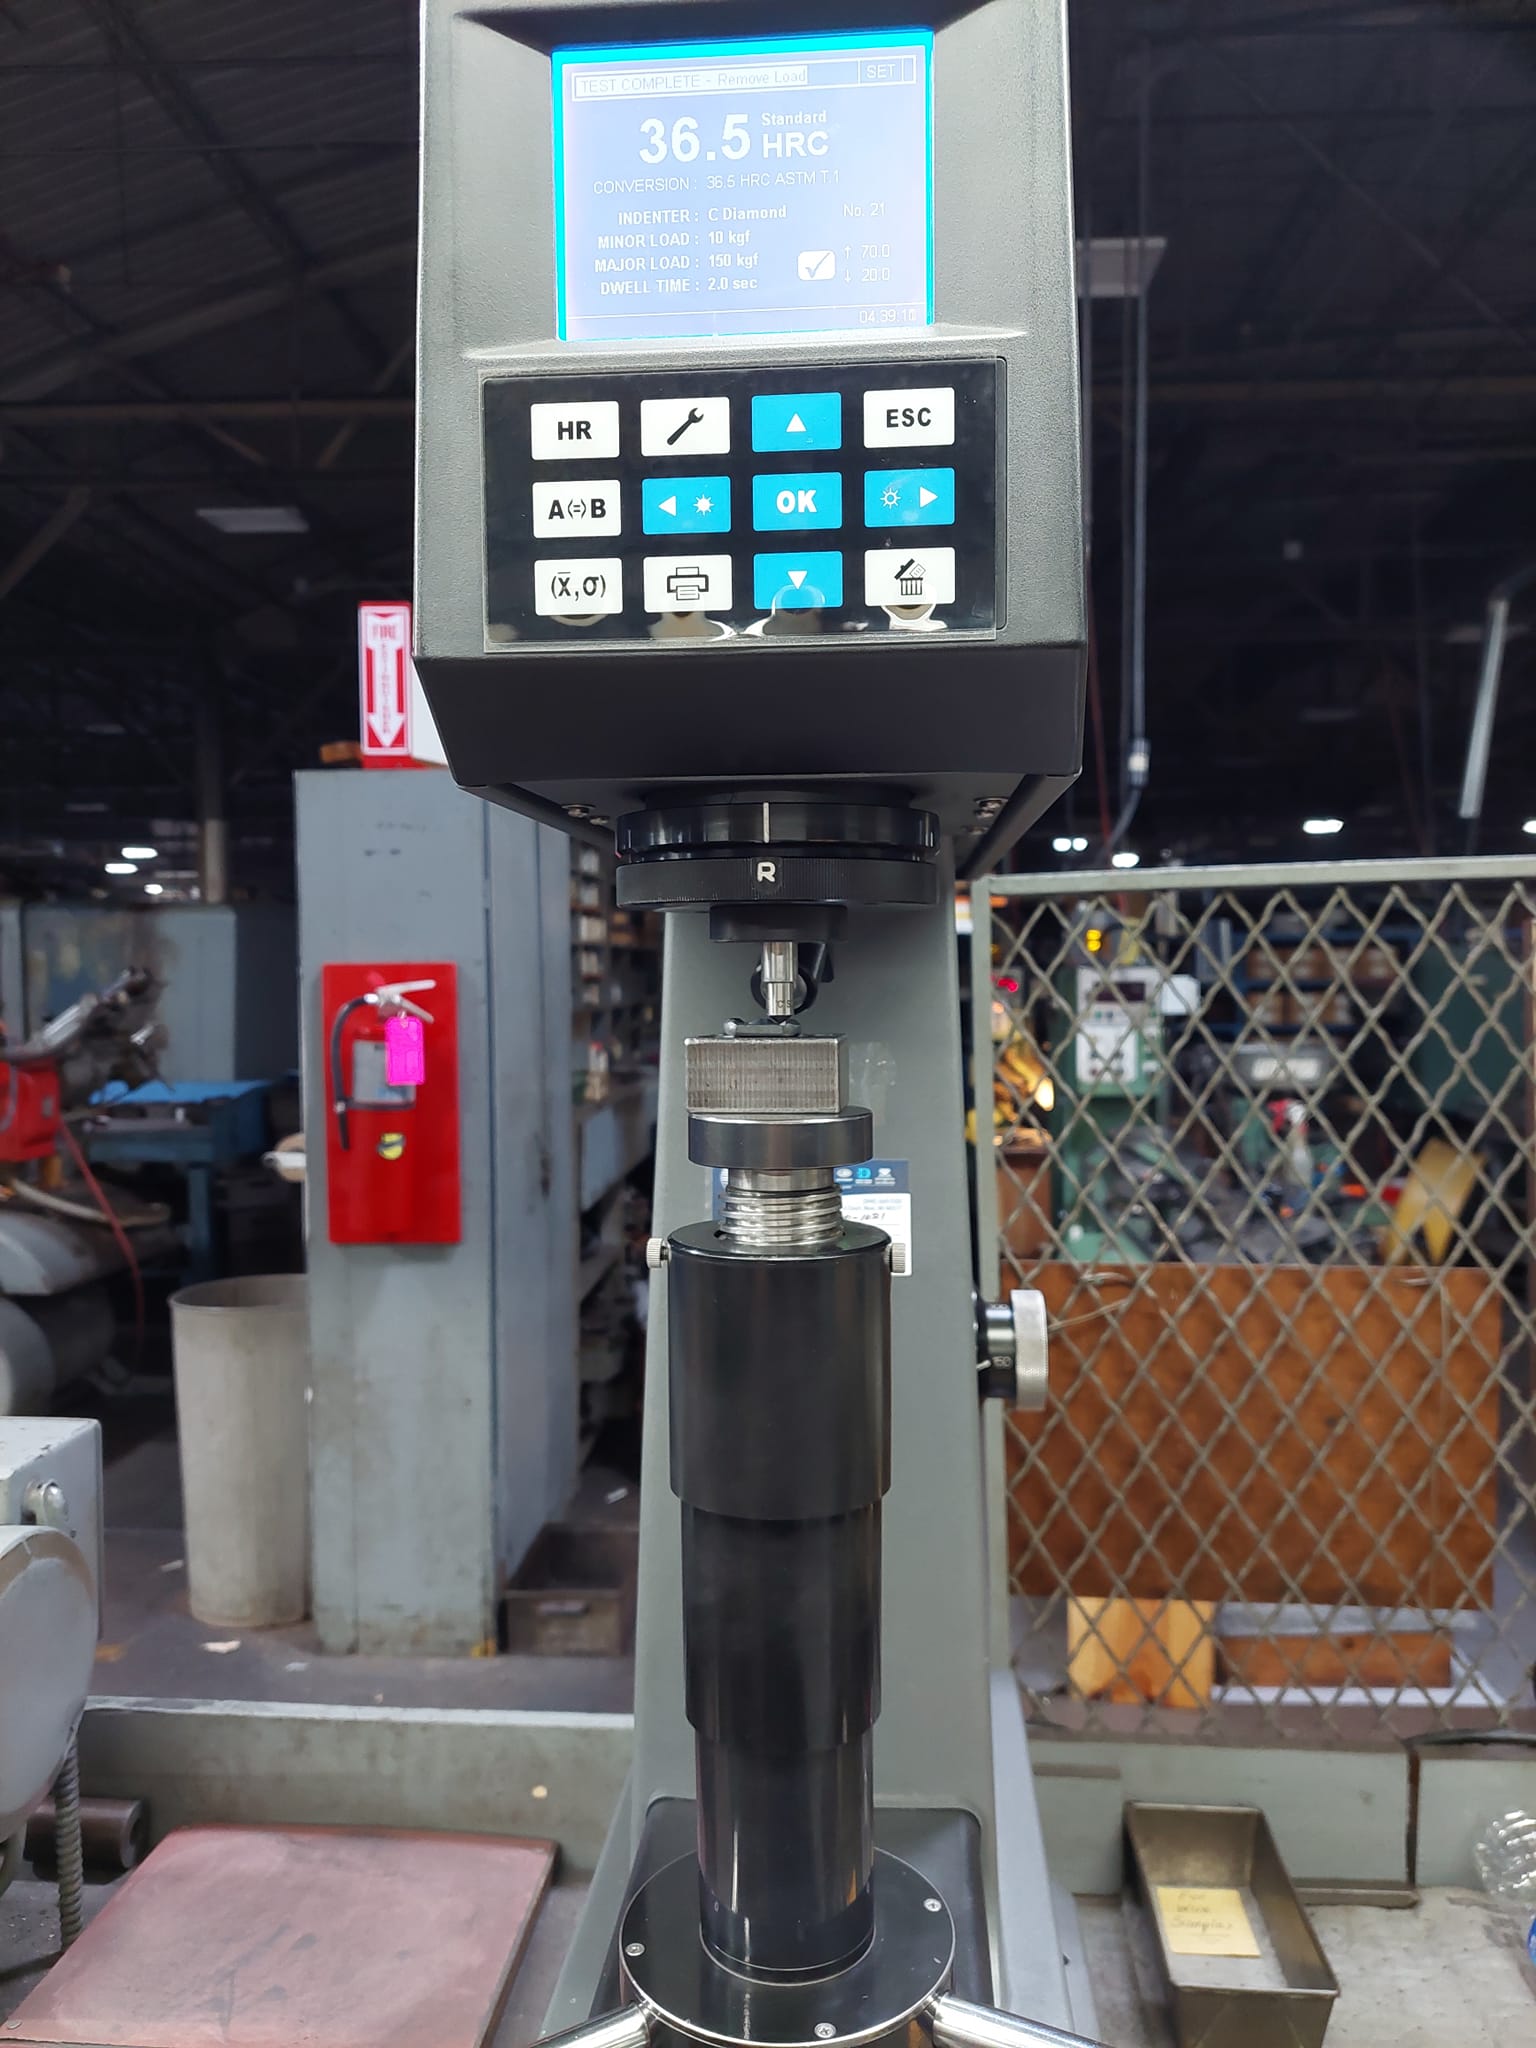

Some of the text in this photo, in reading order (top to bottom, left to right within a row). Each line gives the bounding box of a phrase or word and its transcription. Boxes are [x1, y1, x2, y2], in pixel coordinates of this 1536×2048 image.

[581, 78, 617, 93] TEST
[621, 73, 700, 91] COMPLETE
[717, 71, 770, 87] Remove
[774, 67, 806, 84] Load
[866, 64, 897, 79] SET
[761, 110, 827, 127] Standard
[639, 113, 829, 164] 36.5 HRC
[593, 177, 690, 195] CONVERSION
[706, 174, 736, 190] 36.5
[740, 172, 770, 188] HRC
[775, 171, 816, 186] ASTM
[618, 209, 690, 225] INDENTER
[708, 208, 718, 222] C
[723, 205, 787, 221] Diamond
[870, 202, 886, 216] 21
[598, 234, 646, 250] MINOR
[650, 233, 690, 248] LOAD
[708, 231, 724, 245] 10
[728, 229, 751, 247] kgf
[861, 244, 890, 259] 70.0
[595, 257, 646, 273] MAJOR
[650, 256, 690, 271] LOAD
[708, 253, 732, 268] 150
[736, 252, 760, 270] kgf
[861, 267, 890, 282] 20.0
[601, 280, 650, 296] DWELL
[656, 279, 690, 293] TIME
[708, 277, 729, 291] 2.0
[732, 278, 758, 291] sec
[886, 407, 932, 428] ESC
[558, 421, 592, 441] HR
[776, 490, 817, 514] OK
[756, 861, 776, 882] R
